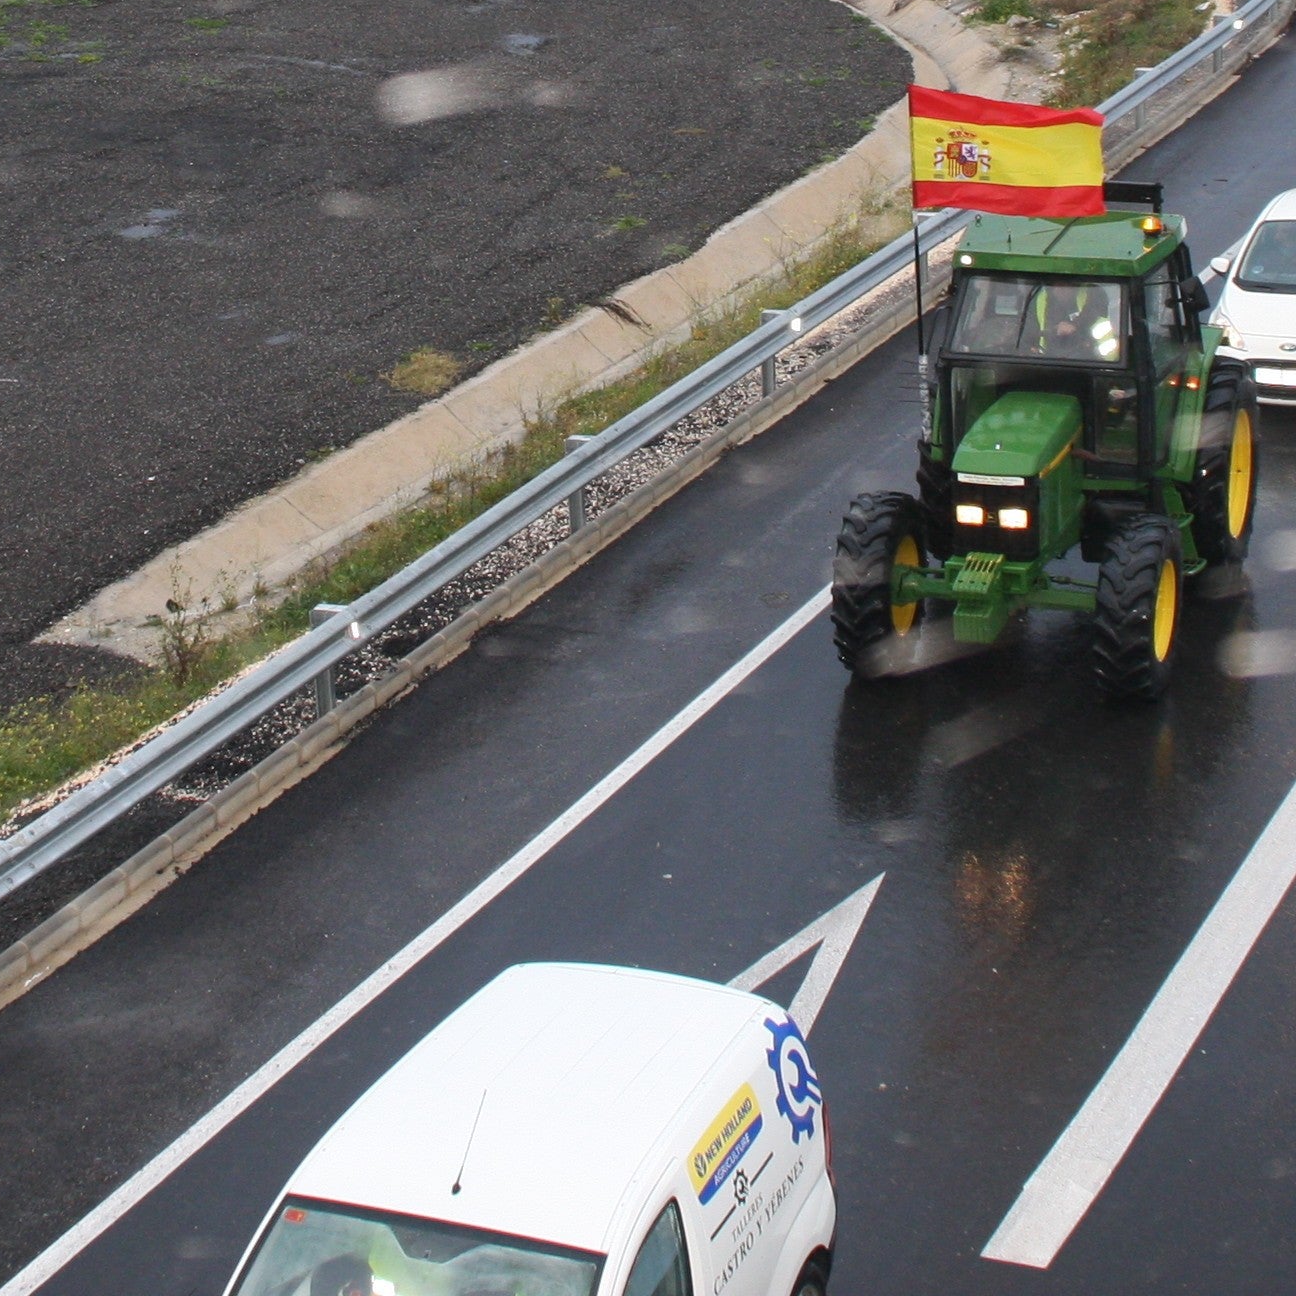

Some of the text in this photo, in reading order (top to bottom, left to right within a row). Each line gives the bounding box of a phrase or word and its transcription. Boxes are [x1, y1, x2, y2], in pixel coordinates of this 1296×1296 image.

[705, 1097, 752, 1164] NEW HOLLAND
[714, 1132, 750, 1186] AGRICULTURE
[731, 1191, 764, 1242] TALLERES
[714, 1231, 754, 1296] CASTRO
